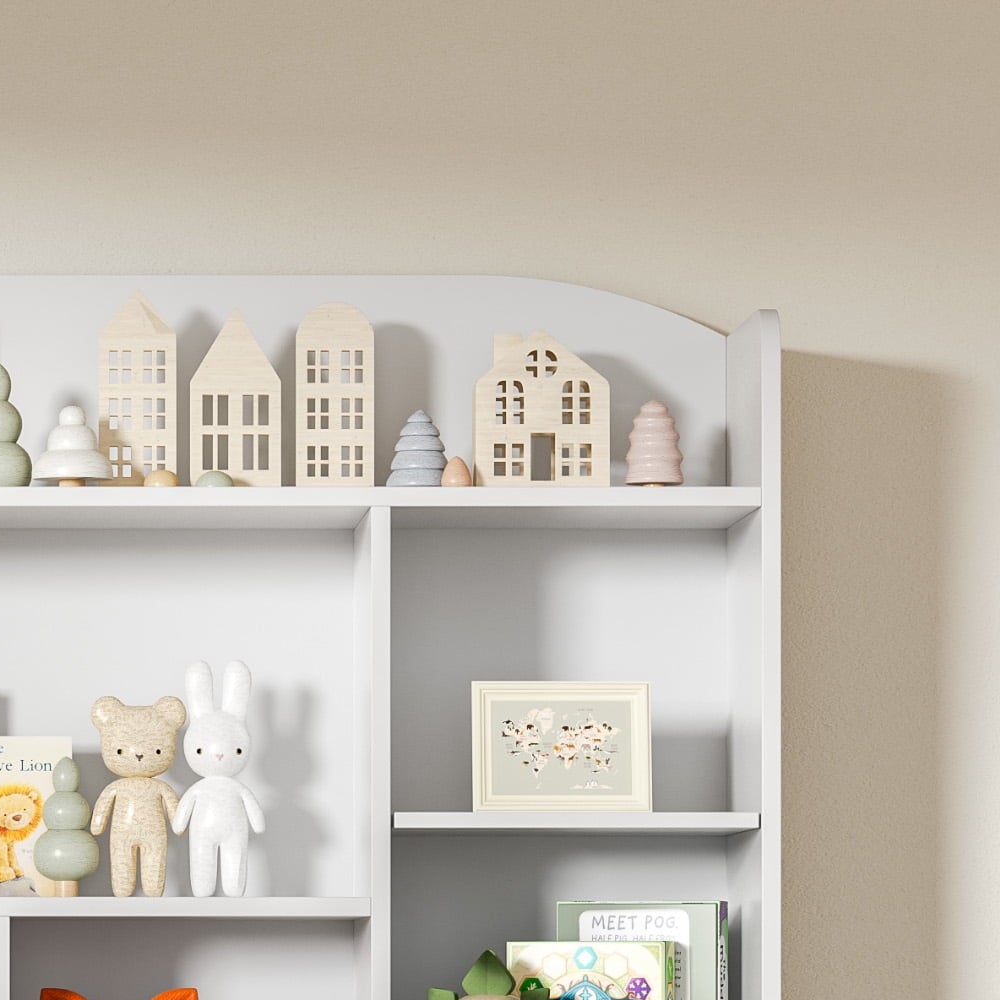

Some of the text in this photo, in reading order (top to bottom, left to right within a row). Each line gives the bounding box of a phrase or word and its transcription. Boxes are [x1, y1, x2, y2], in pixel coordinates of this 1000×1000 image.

[20, 759, 53, 772] Lion
[591, 914, 680, 931] MEET POG.
